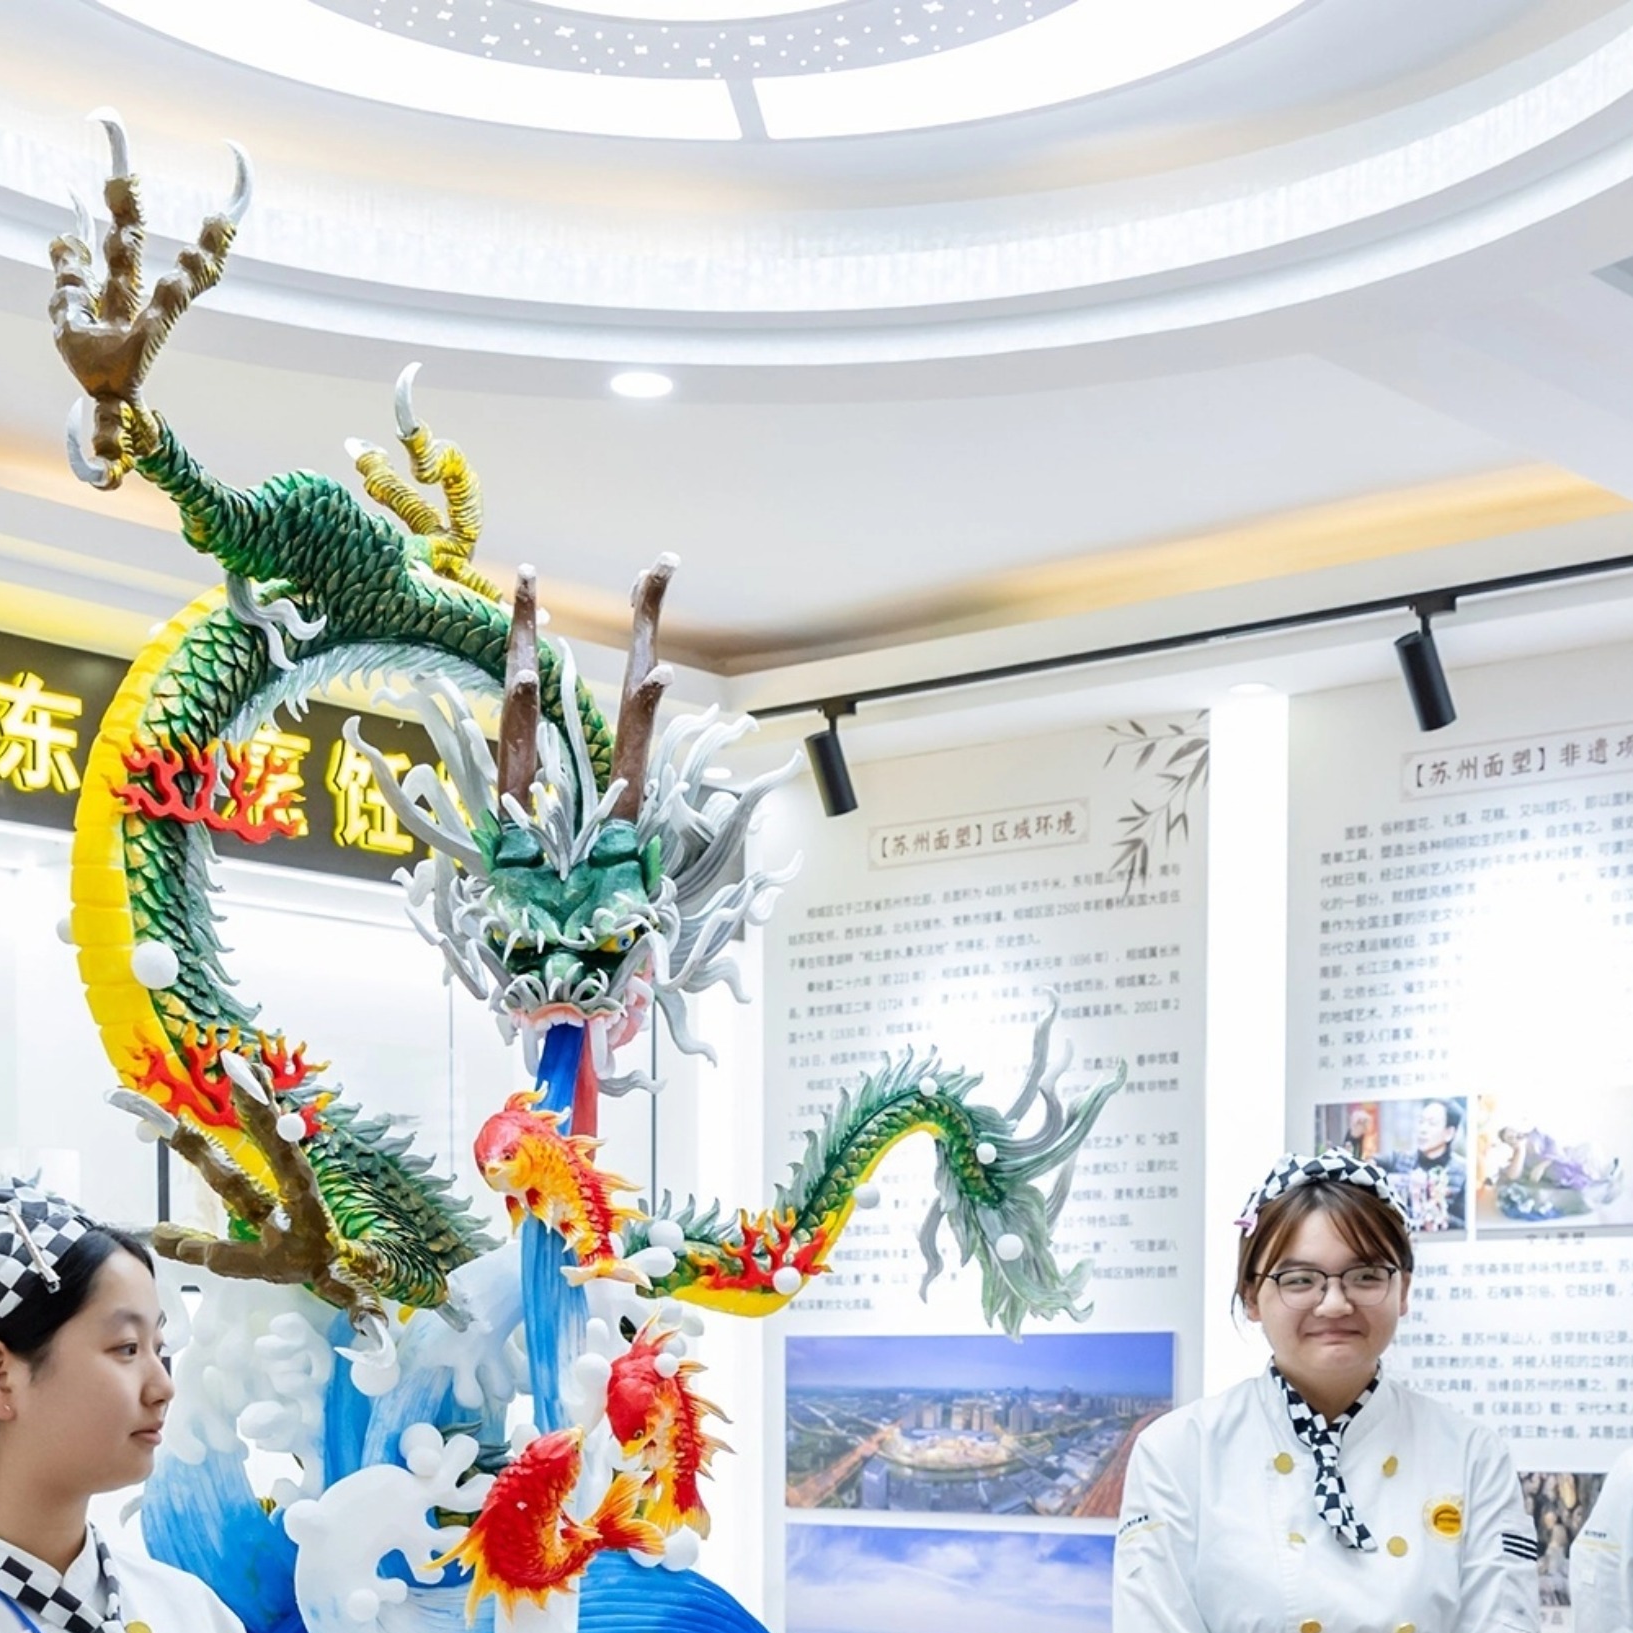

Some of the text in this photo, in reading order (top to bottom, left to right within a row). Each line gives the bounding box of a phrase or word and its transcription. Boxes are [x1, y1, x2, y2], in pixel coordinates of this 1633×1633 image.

[879, 809, 1078, 859] 【苏州面塑】区域环境
